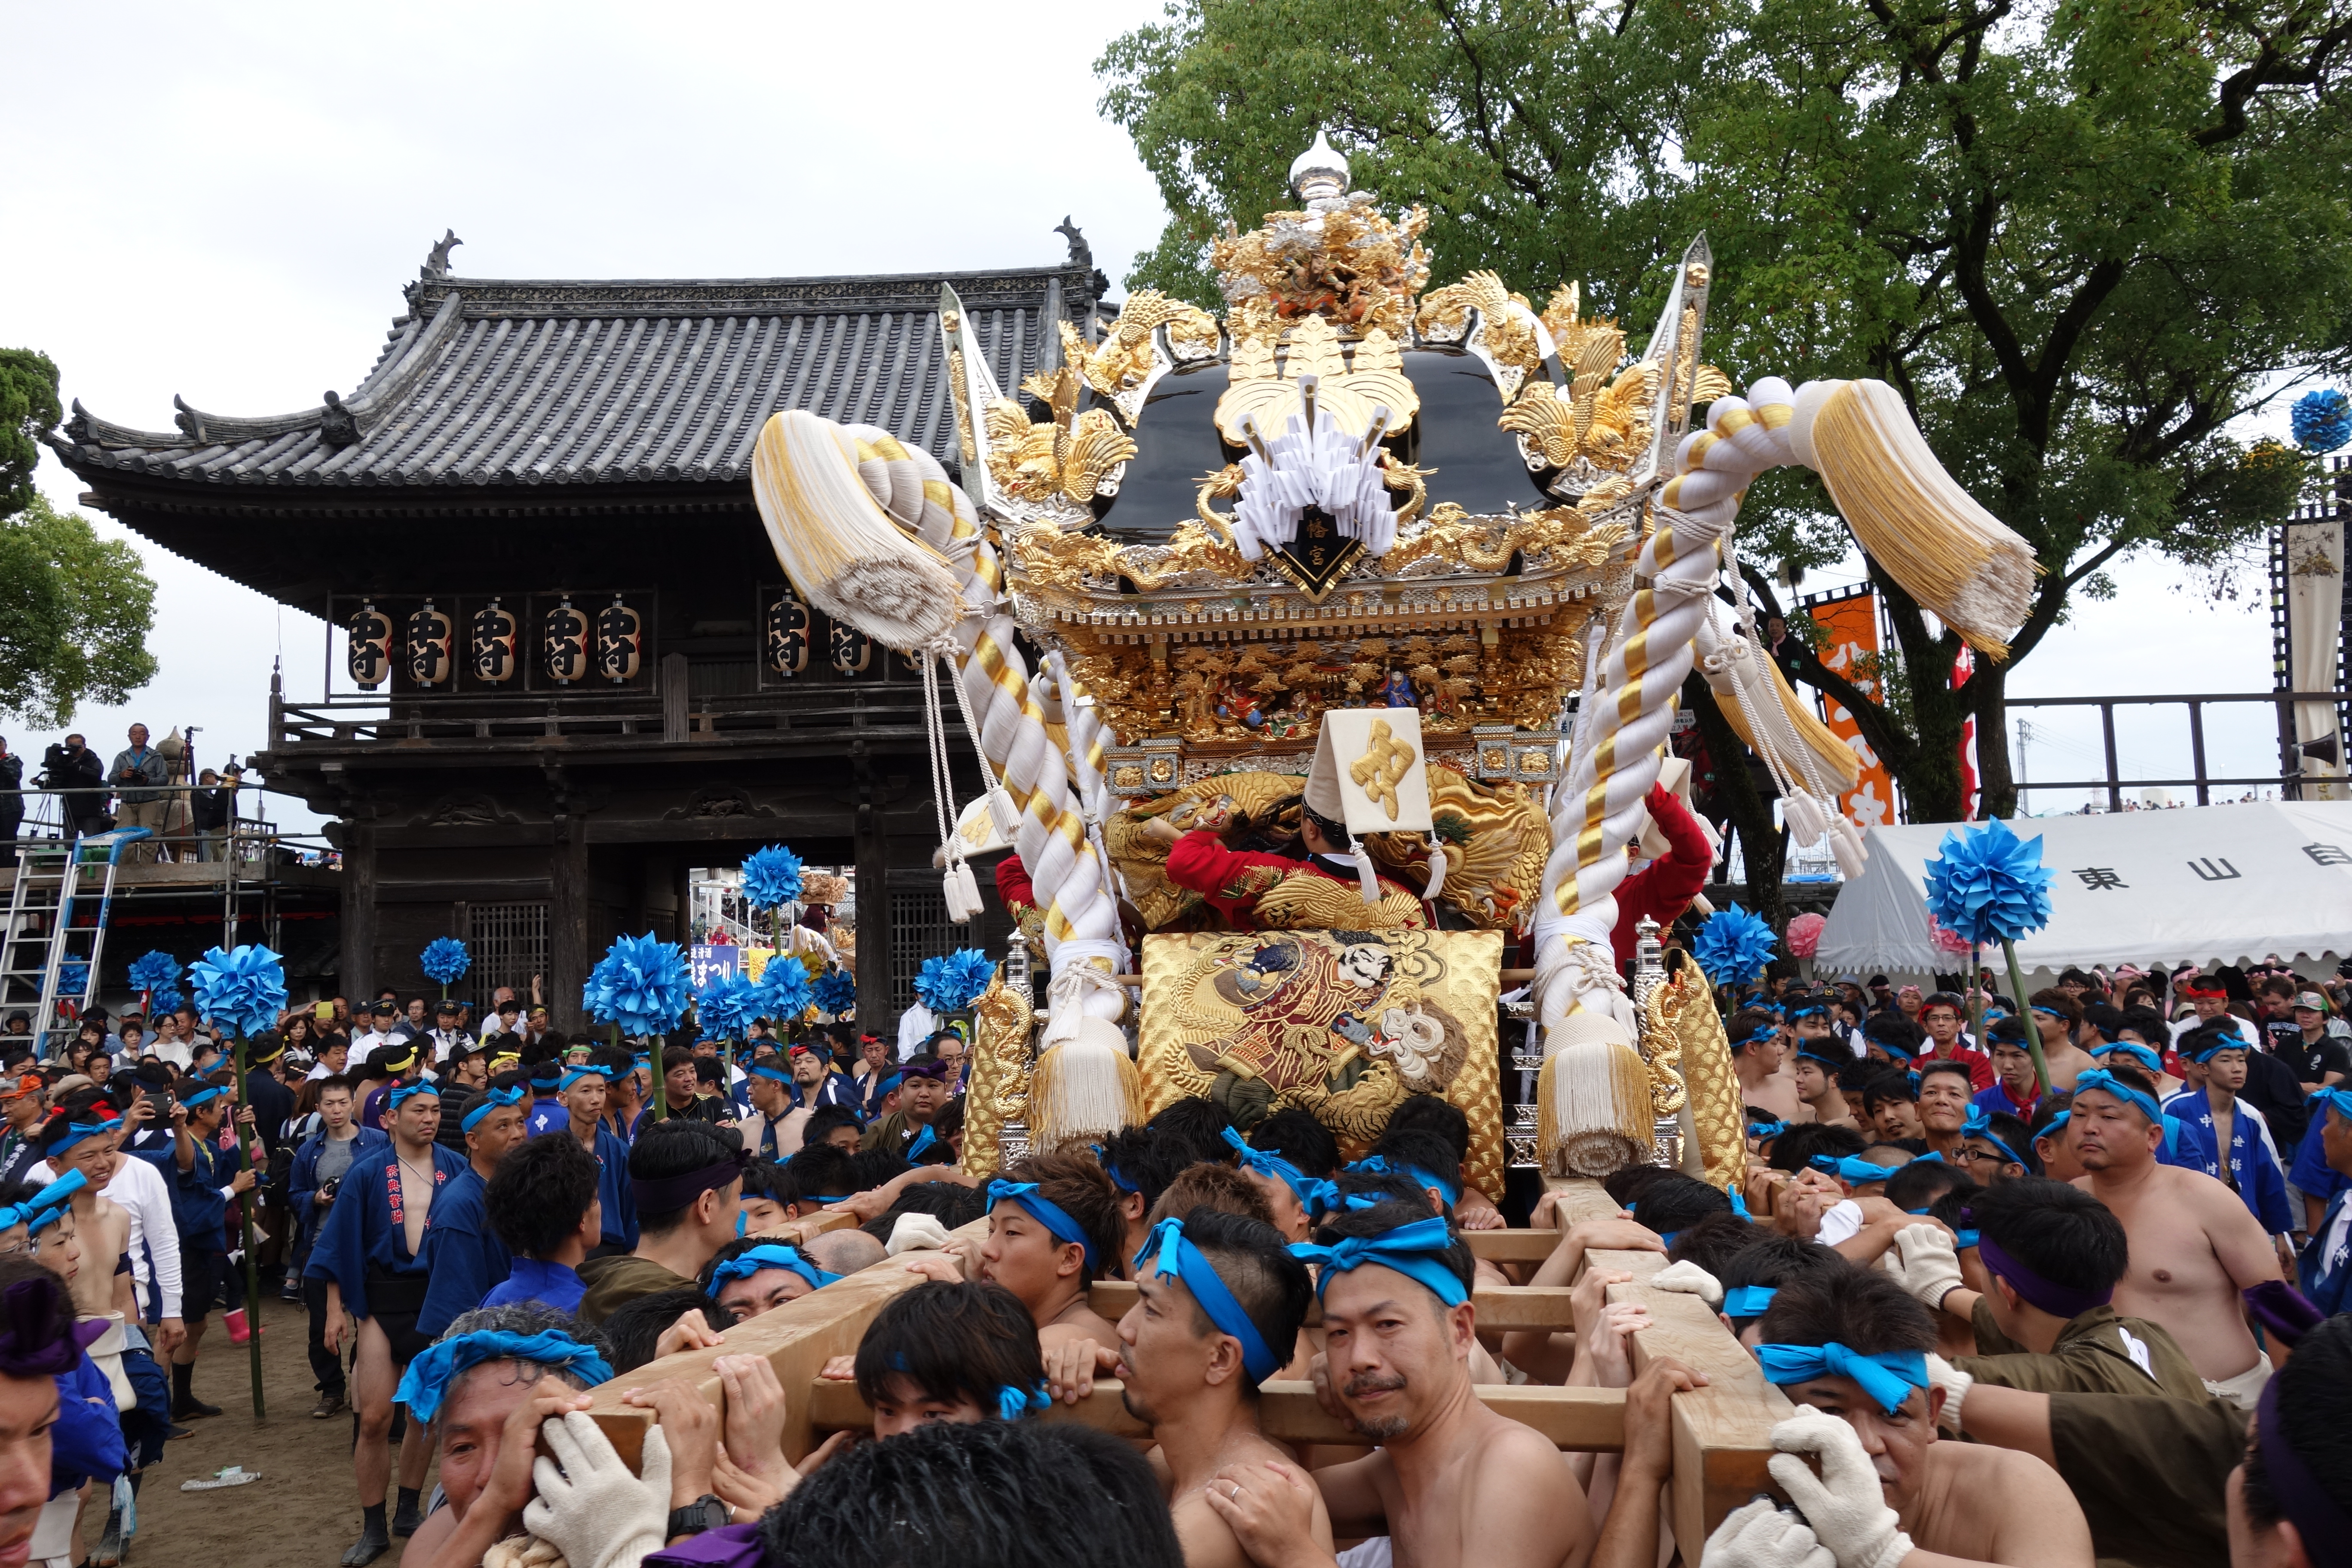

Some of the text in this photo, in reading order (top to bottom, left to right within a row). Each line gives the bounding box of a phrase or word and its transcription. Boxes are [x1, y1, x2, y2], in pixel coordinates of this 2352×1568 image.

[1306, 504, 1329, 565] 幡宮
[348, 612, 386, 679] 中村
[408, 612, 446, 679] 中村
[473, 611, 511, 676] 中村
[545, 609, 582, 676] 中村
[599, 608, 636, 674] 中村
[769, 602, 805, 669] 中村
[1350, 717, 1415, 821] 中
[535, 1114, 548, 1131] 中
[902, 1130, 911, 1139] 中
[386, 1164, 404, 1225] 祭典警備
